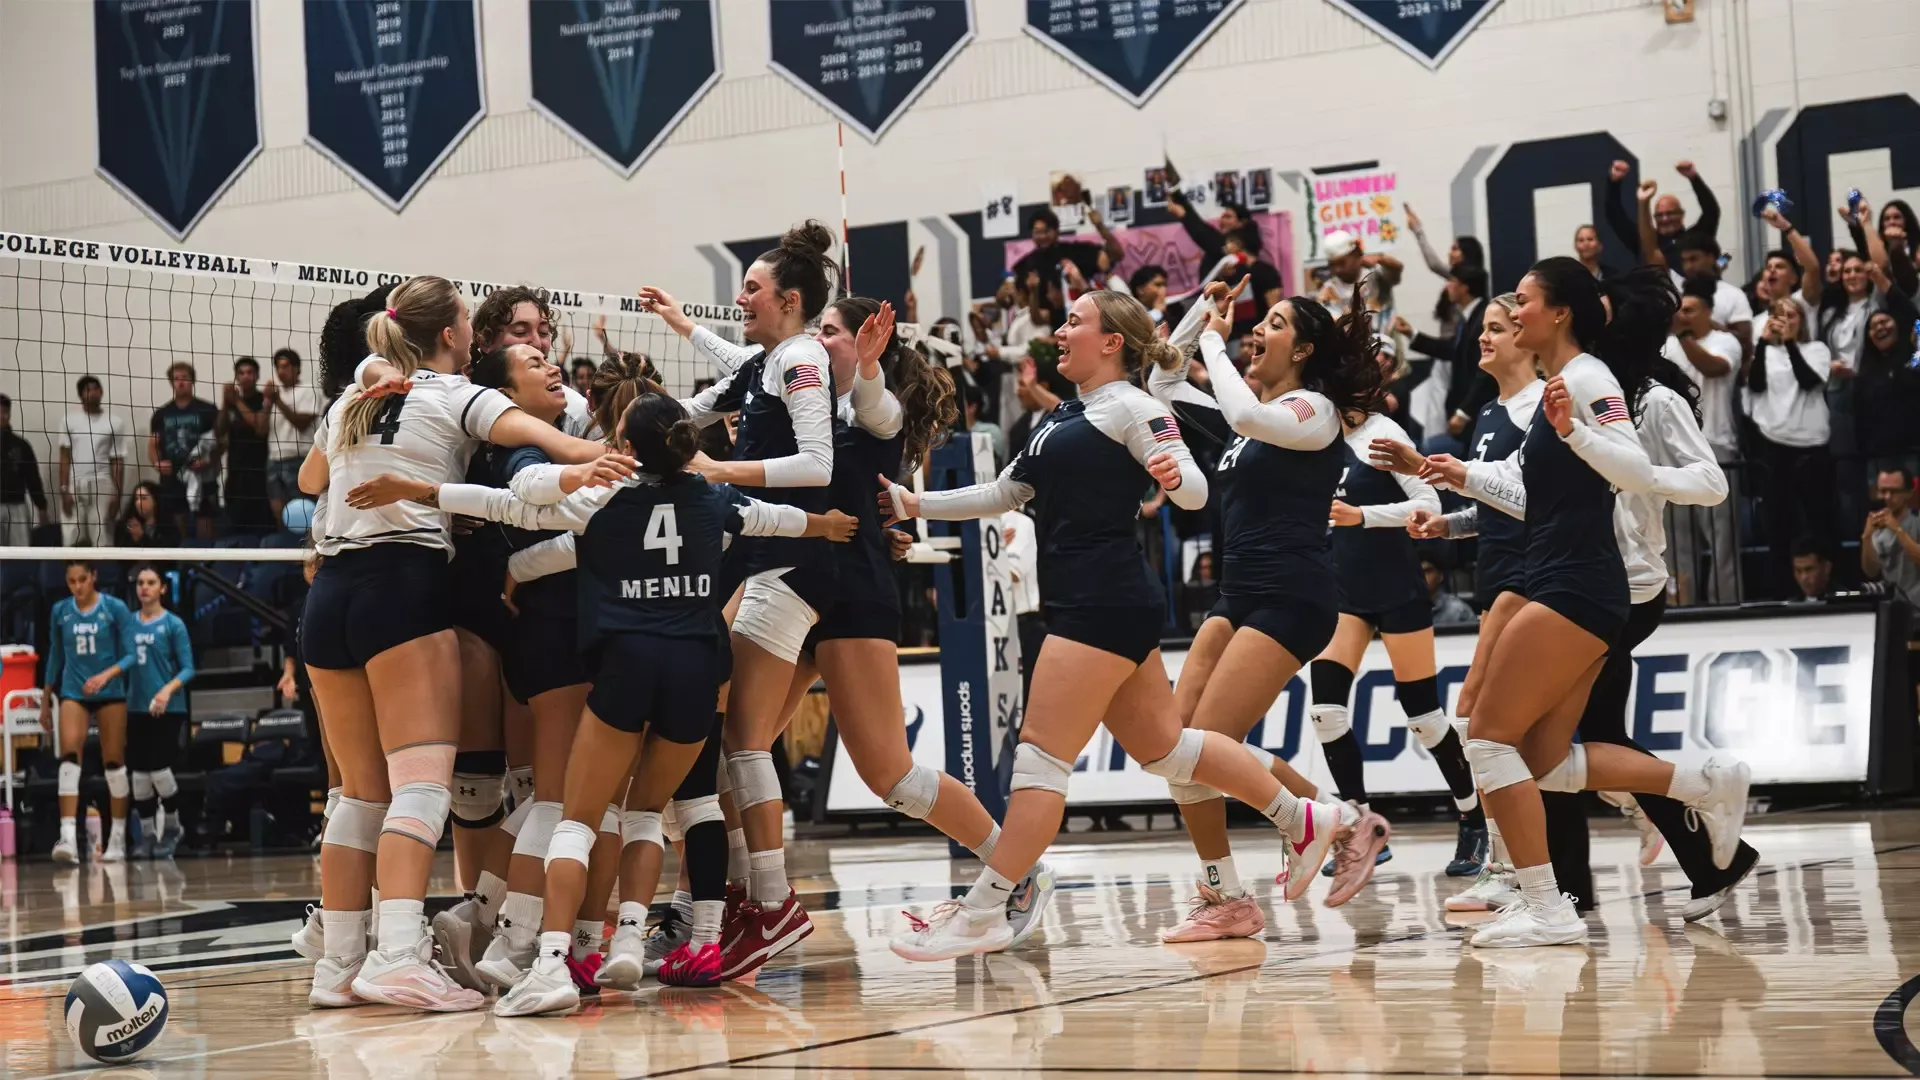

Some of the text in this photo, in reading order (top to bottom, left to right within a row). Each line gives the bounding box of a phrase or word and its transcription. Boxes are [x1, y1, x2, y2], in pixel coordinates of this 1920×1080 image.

[560, 7, 681, 36] National Championship
[804, 6, 936, 36] National Championship
[587, 26, 654, 48] Appearances
[833, 27, 907, 48] Appearances
[894, 40, 923, 57] 2012
[335, 54, 449, 84] National Championship
[821, 68, 849, 84] 2013
[361, 74, 424, 95] Appearances
[1320, 200, 1367, 222] GIRL
[108, 244, 251, 275] VOLLEYBALL
[298, 265, 369, 286] MENLO
[683, 304, 743, 322] COLLEG
[643, 503, 683, 565] 4
[617, 574, 711, 599] MENLO
[76, 635, 97, 655] 21
[136, 645, 147, 665] 5
[957, 681, 973, 732] sports
[106, 1004, 158, 1042] molten
